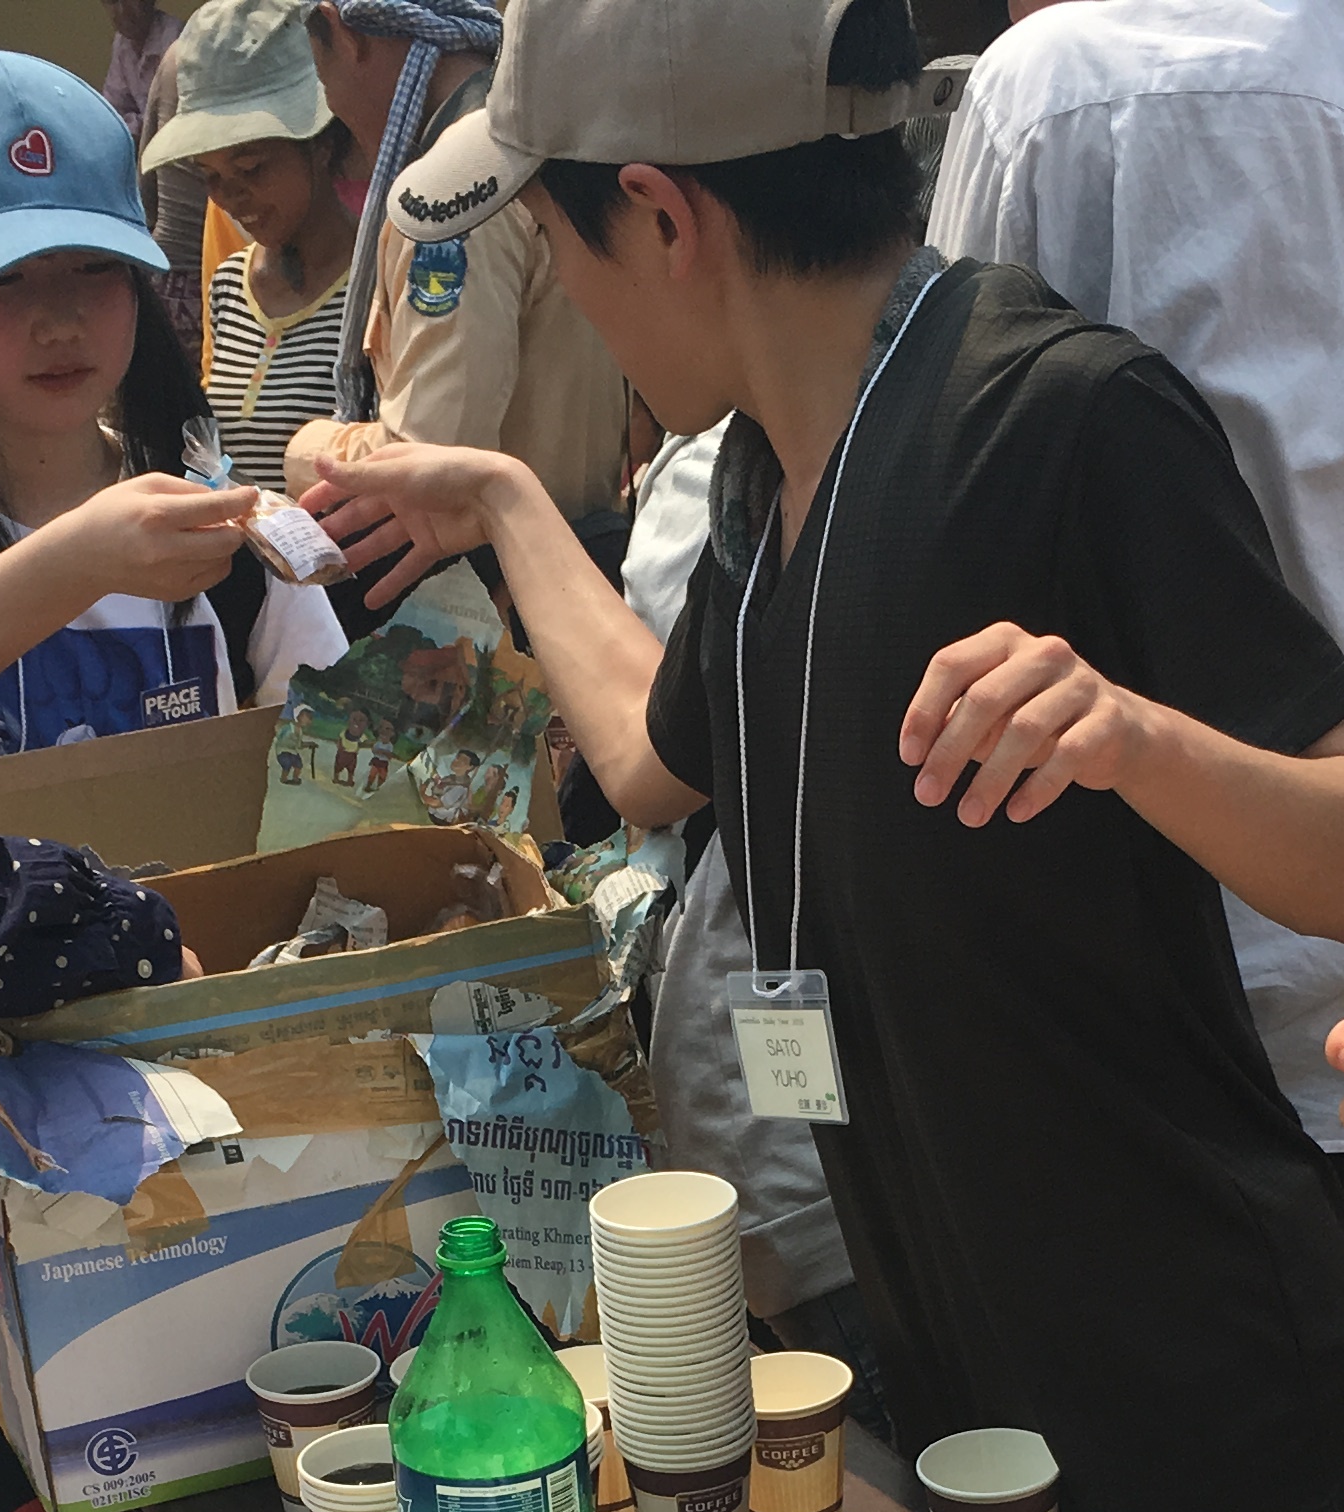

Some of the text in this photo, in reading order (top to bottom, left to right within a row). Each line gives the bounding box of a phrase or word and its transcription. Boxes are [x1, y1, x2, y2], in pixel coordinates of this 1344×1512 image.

[145, 685, 201, 715] PEACE
[163, 701, 201, 721] TOUR
[766, 1039, 801, 1057] SATO
[771, 1069, 807, 1088] YUHO
[544, 1227, 589, 1245] Khmer
[41, 1235, 228, 1283] Japanese Technology
[535, 1256, 566, 1276] Reap,
[570, 1259, 585, 1273] 13
[762, 1444, 819, 1460] COFFEE
[82, 1483, 101, 1496] CS
[685, 1489, 740, 1512] COFFEE
